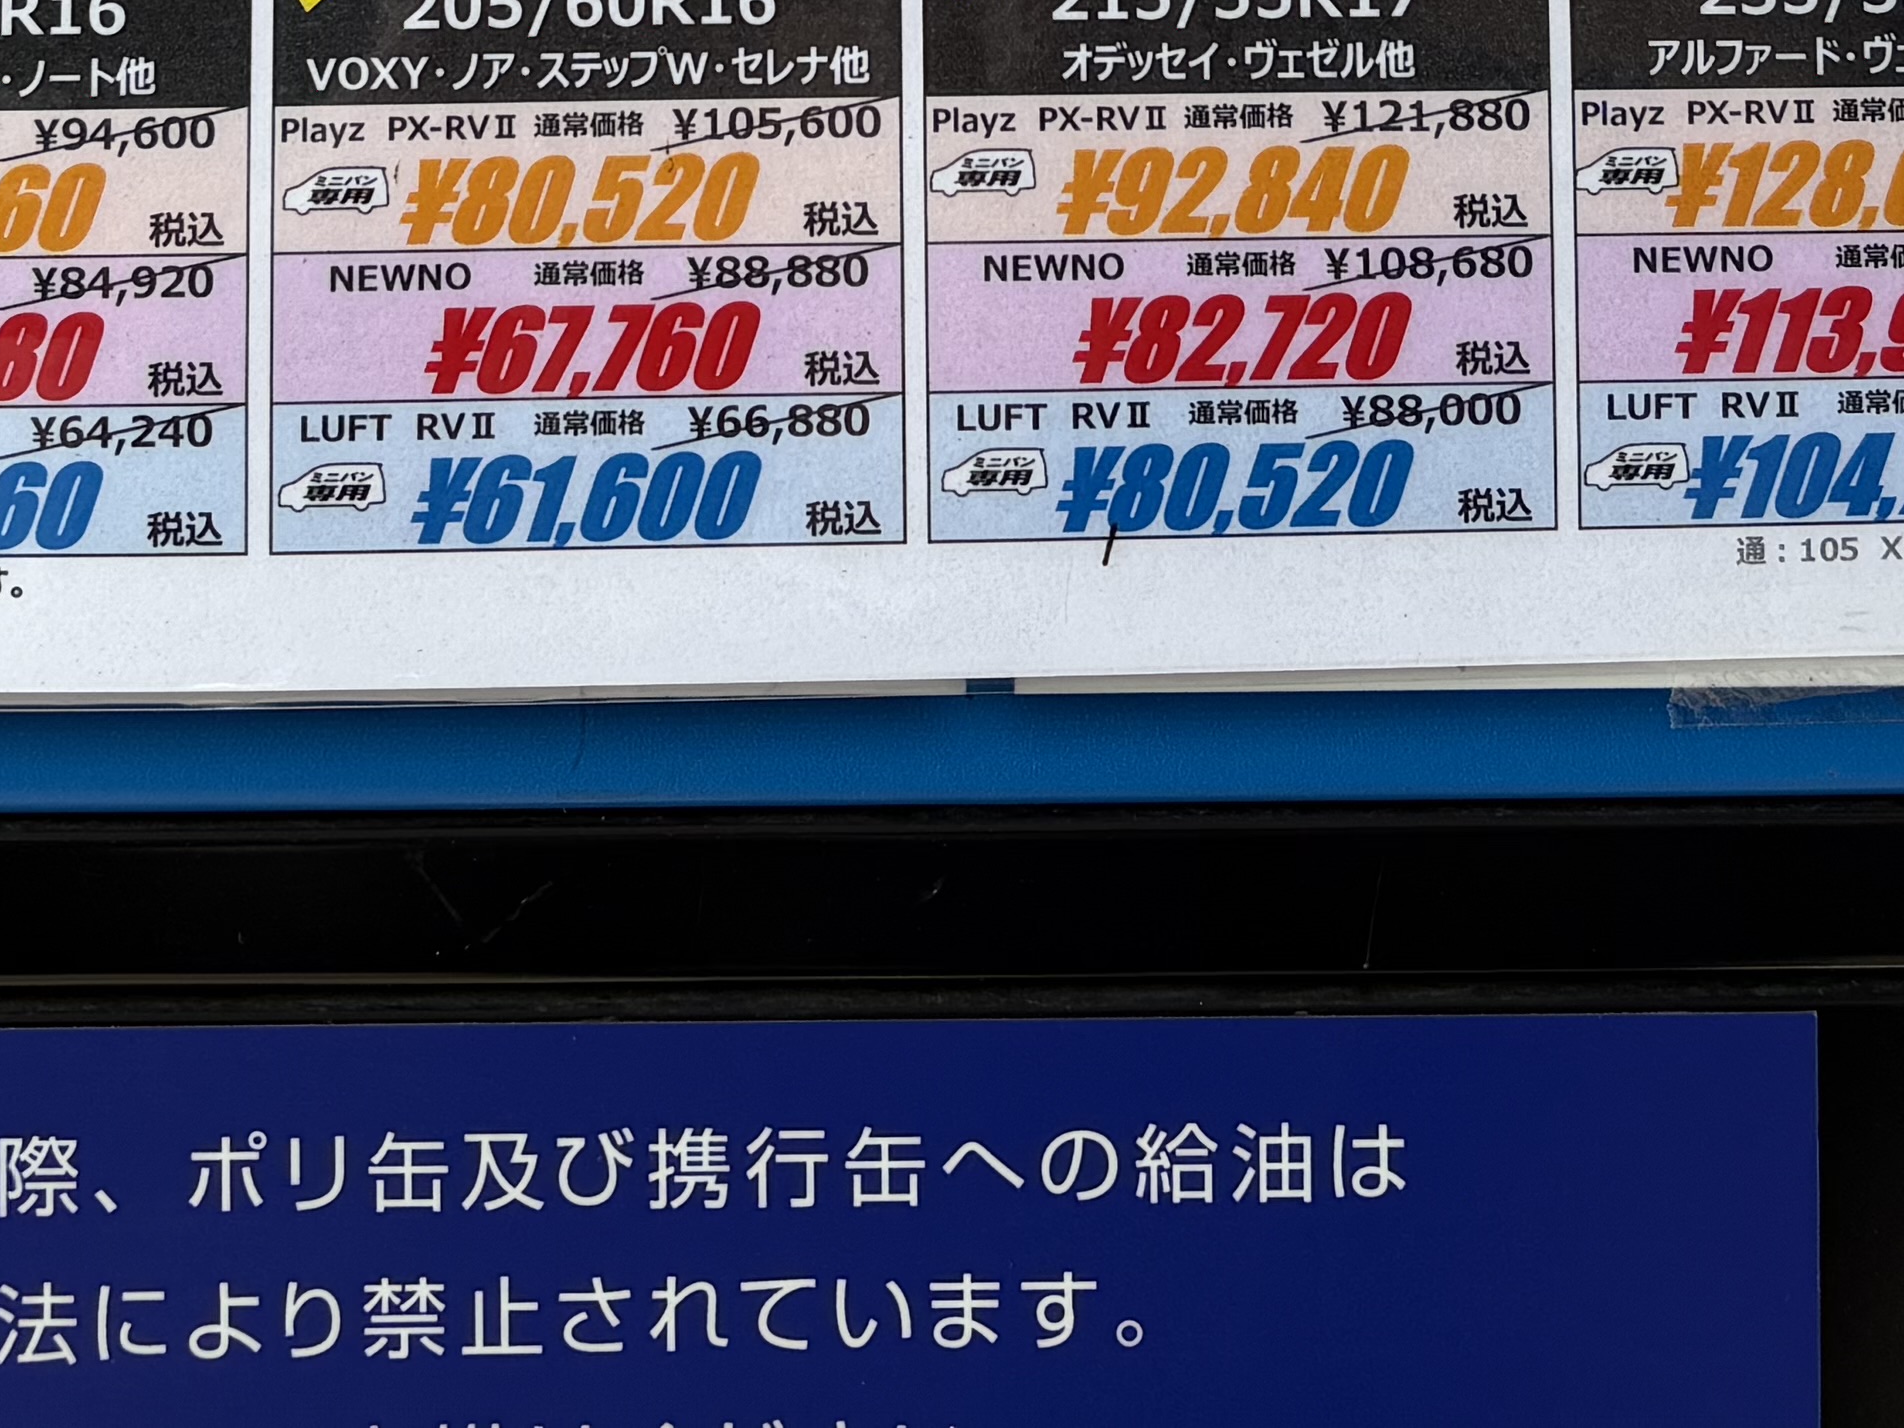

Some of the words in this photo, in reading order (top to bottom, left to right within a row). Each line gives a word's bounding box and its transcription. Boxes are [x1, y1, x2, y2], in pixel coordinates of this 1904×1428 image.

[1582, 101, 1664, 132] Playz
[401, 153, 759, 249] ¥80,520
[1057, 146, 1409, 240] ¥92,840
[958, 404, 1047, 431] LUFT
[1341, 392, 1522, 430] ¥88,000
[412, 451, 761, 550] ¥61,600
[1056, 440, 1414, 542] ¥80,520
